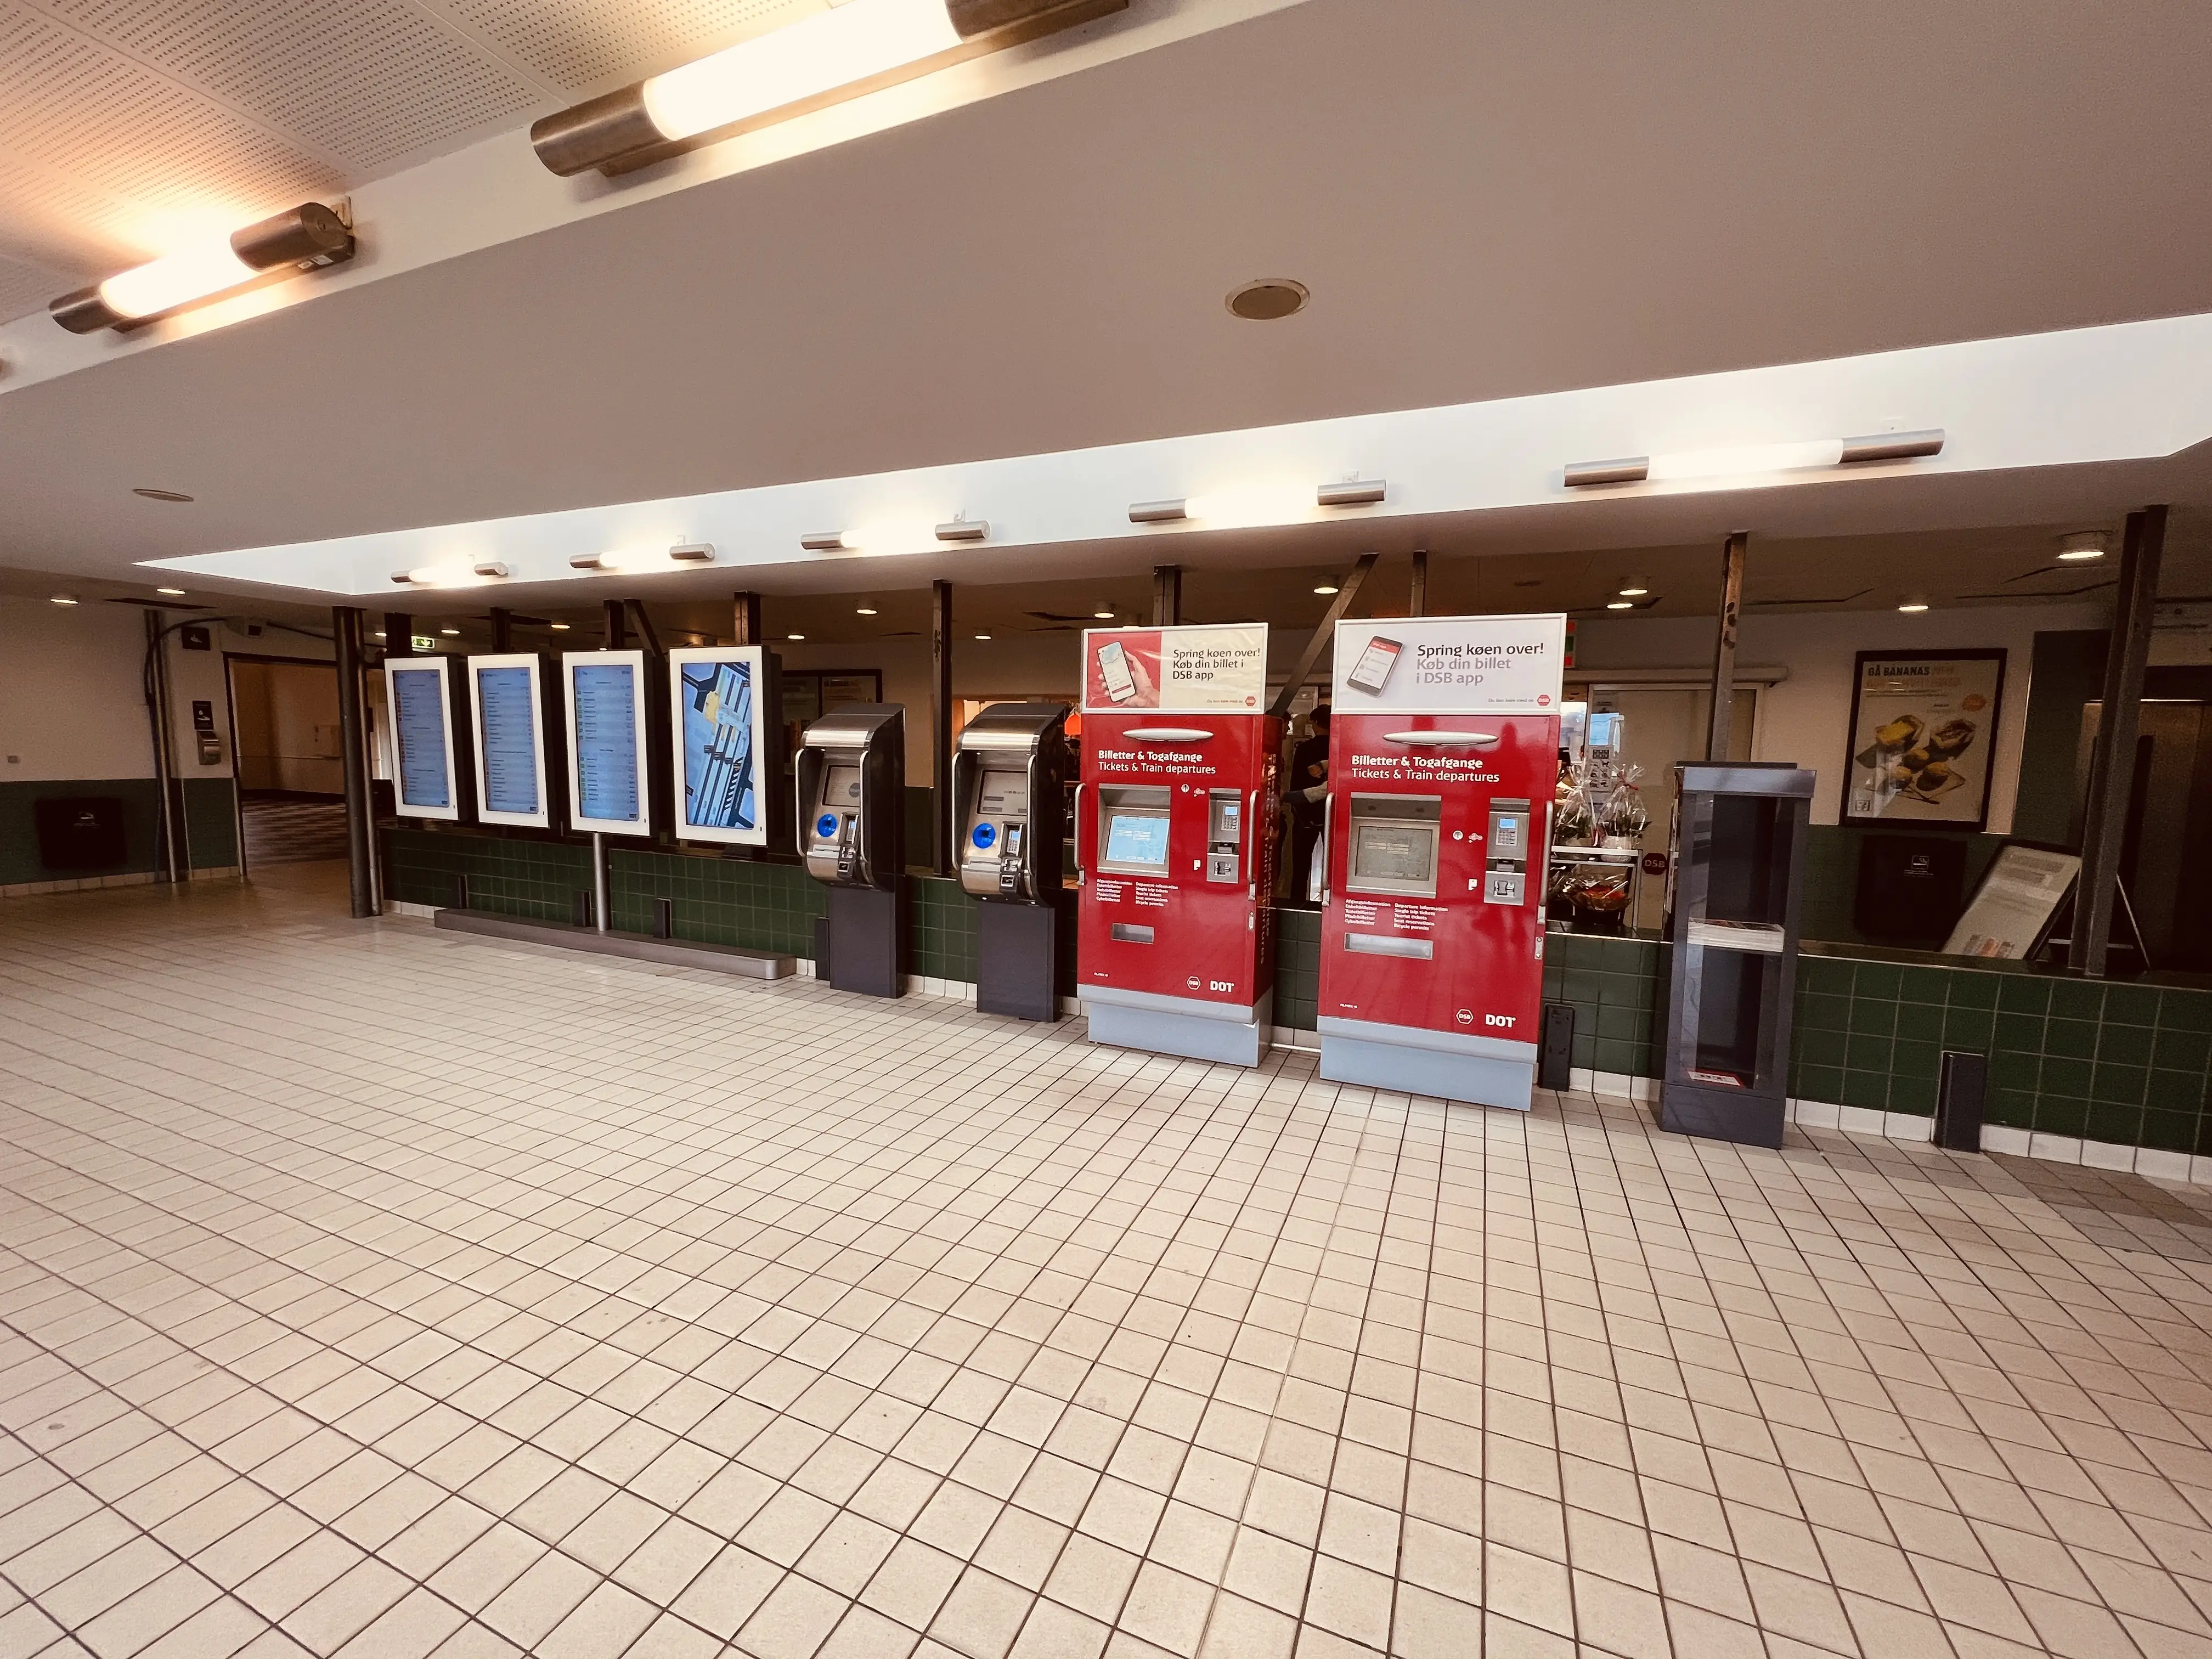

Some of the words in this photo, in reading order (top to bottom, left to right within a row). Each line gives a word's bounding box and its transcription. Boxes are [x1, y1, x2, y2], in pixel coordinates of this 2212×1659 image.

[1173, 648, 1204, 659] Spring
[1207, 648, 1232, 657] køen
[1234, 647, 1260, 657] over!
[1417, 645, 1462, 658] Spring
[1466, 644, 1502, 656] køen
[1506, 643, 1544, 654] over!
[1173, 659, 1192, 669] Køb
[1195, 659, 1210, 668] din
[1213, 659, 1238, 668] billet
[1240, 659, 1244, 668] i
[1417, 658, 1445, 670] Køb
[1448, 658, 1471, 669] din
[1475, 657, 1511, 669] billet
[1868, 664, 1881, 676] GÅ
[1883, 666, 1930, 676] BANANAS
[1172, 670, 1193, 680] DSB
[1195, 672, 1214, 681] app
[1416, 673, 1420, 684] i
[1424, 672, 1453, 684] DSB
[1457, 674, 1484, 686] app
[1098, 750, 1135, 760] Billetter
[1137, 751, 1145, 760] &
[1147, 751, 1203, 763] Togafgange
[1352, 755, 1398, 766] Billetter
[1401, 757, 1410, 767] &
[1413, 757, 1483, 769] Togafgange
[1098, 761, 1129, 771] Tickets
[1131, 763, 1138, 771] &
[1141, 763, 1163, 772] Train
[1165, 764, 1216, 775] departures
[1352, 769, 1390, 780] Tickets
[1393, 770, 1402, 780] &
[1406, 770, 1432, 781] Train
[1436, 770, 1499, 783] departures
[1644, 859, 1666, 868] DSB
[1210, 980, 1234, 992] DOT
[1486, 1014, 1516, 1028] DOT
